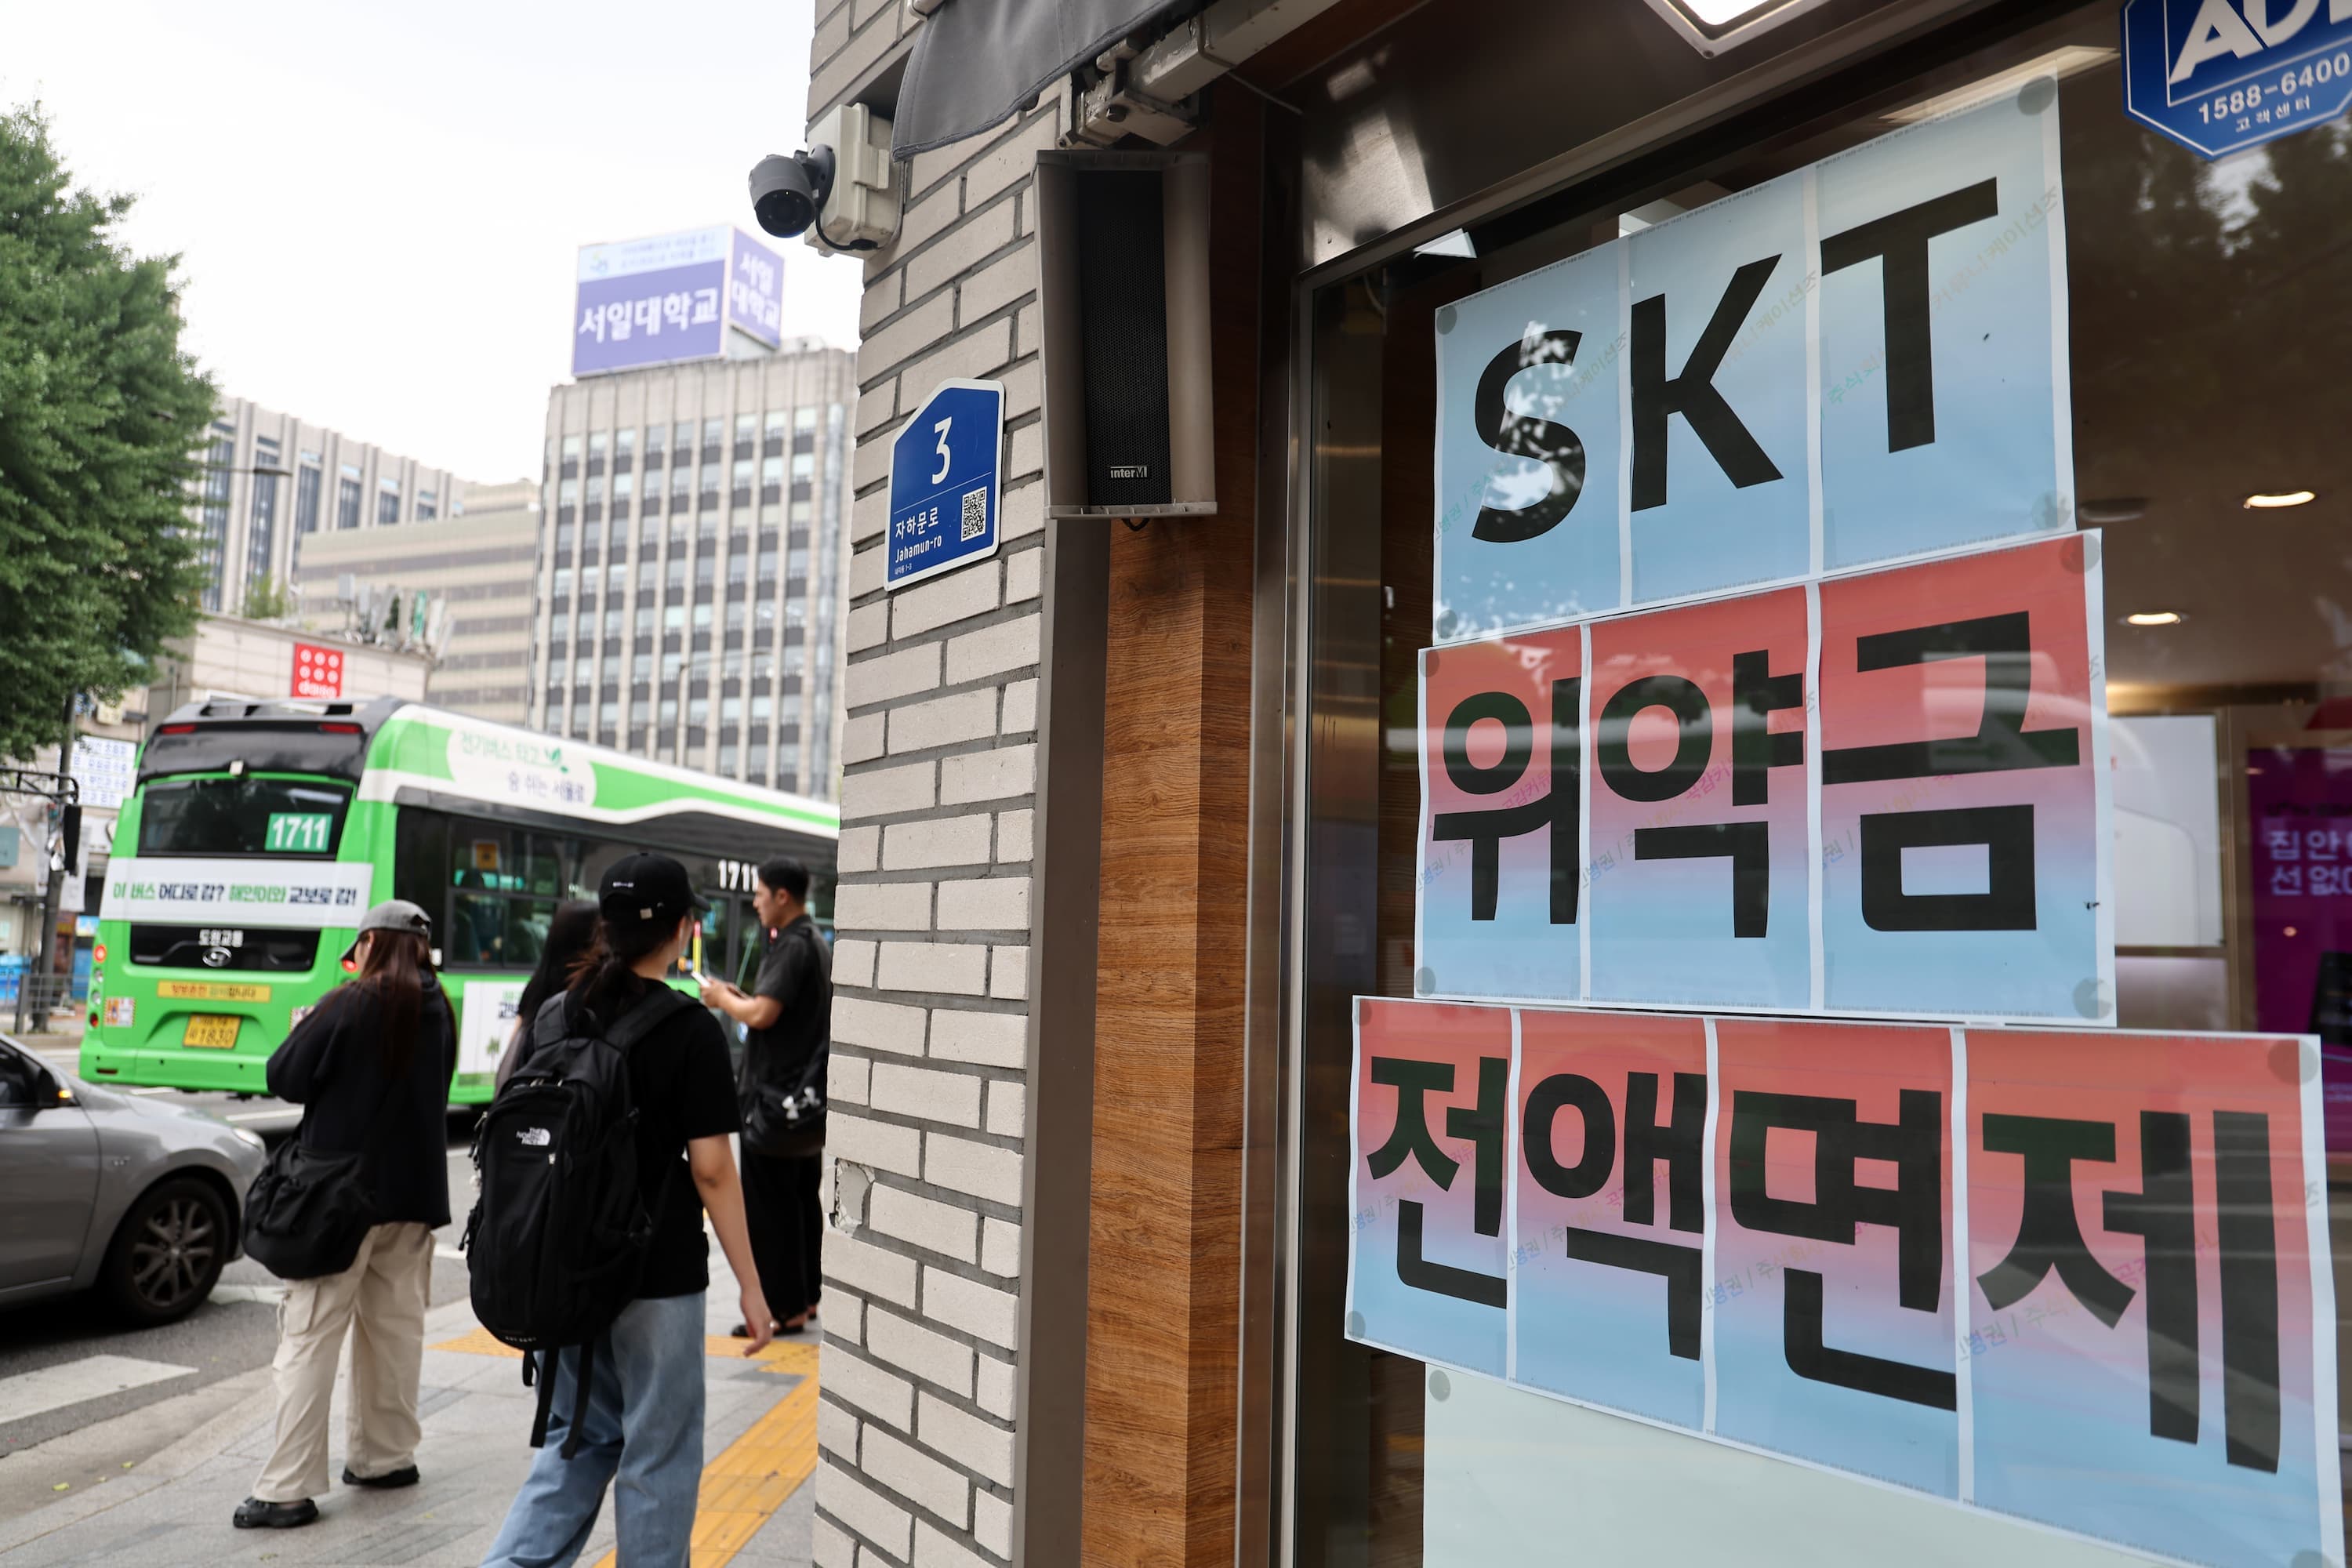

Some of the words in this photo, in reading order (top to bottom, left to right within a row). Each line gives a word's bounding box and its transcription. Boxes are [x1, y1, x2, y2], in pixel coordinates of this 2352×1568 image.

[2169, 0, 2352, 85] AD
[2198, 52, 2350, 125] 1588-6400
[578, 286, 718, 344] 서일대학교
[731, 279, 780, 332] 대학교
[1472, 176, 1998, 543] SKT
[931, 416, 953, 485] 3
[895, 506, 939, 540] 자하문로
[895, 535, 942, 564] Jahamun-ro
[1432, 611, 2079, 938] 위약금
[272, 816, 327, 851] 1711
[112, 882, 126, 899] 이
[130, 882, 156, 900] 버스
[159, 884, 198, 902] 어디로
[201, 884, 224, 902] 감?
[289, 886, 333, 905] 교보로
[718, 859, 759, 892] 1711
[1367, 1056, 2281, 1474] 전액면제
